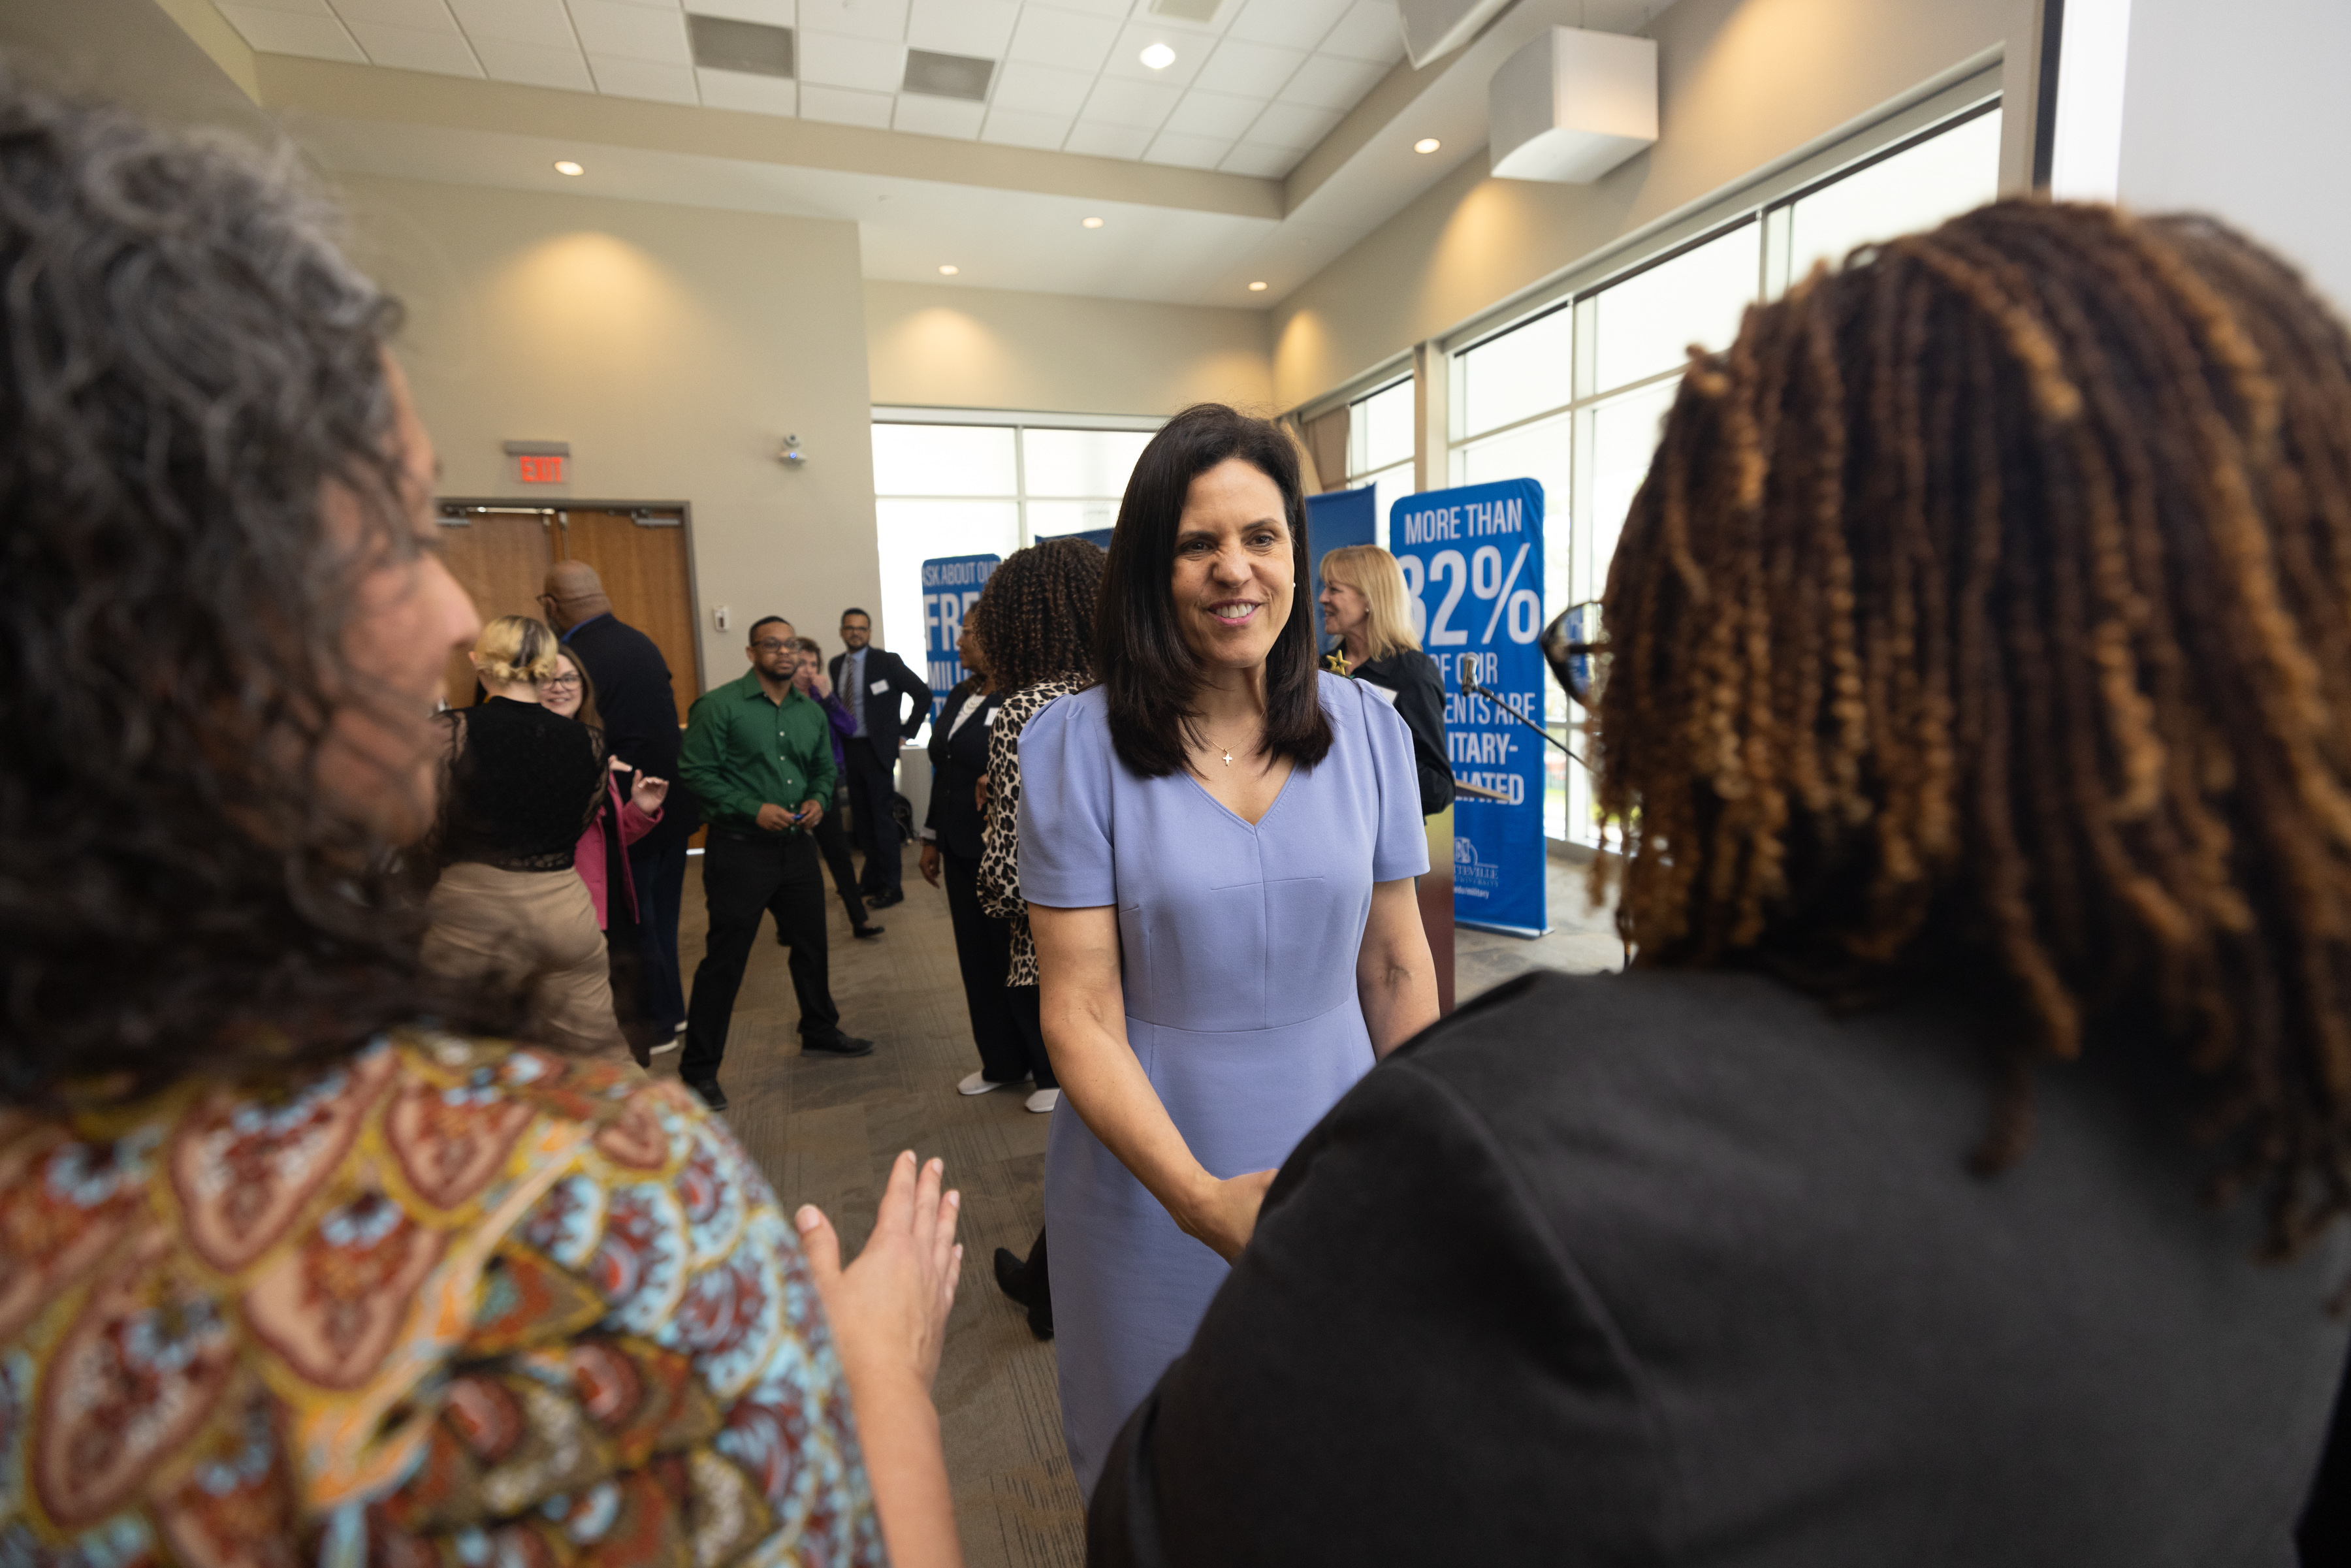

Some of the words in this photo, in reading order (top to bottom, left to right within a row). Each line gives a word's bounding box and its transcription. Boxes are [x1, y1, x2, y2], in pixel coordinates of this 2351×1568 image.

[520, 456, 562, 482] EXIT
[1405, 506, 1461, 545] MORE
[1464, 498, 1522, 538] THAN
[940, 562, 975, 585] ABOUT
[1444, 692, 1491, 725] ENTS
[1494, 692, 1536, 726] ARE
[1447, 731, 1519, 765] ITARY-
